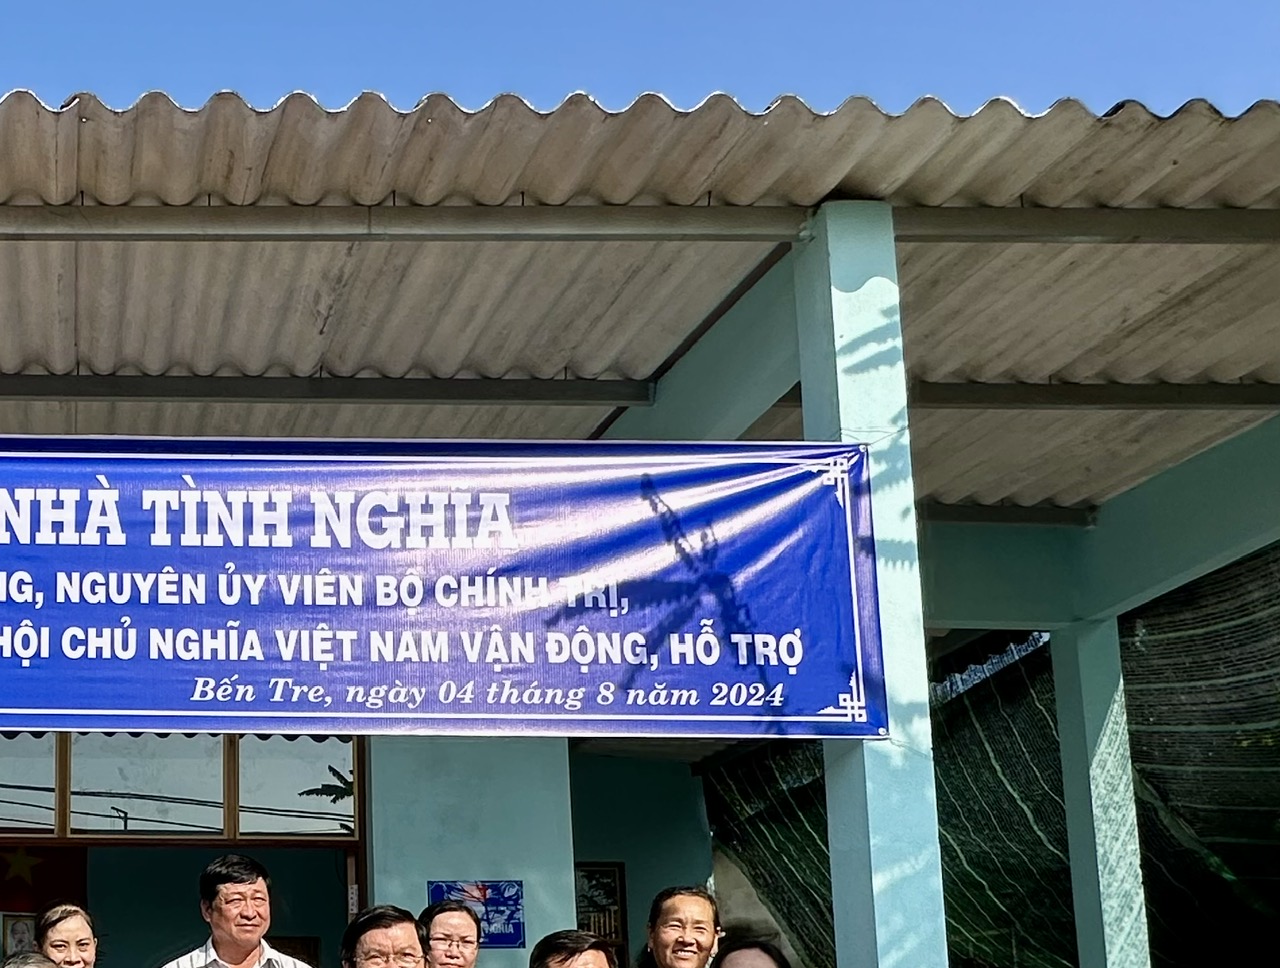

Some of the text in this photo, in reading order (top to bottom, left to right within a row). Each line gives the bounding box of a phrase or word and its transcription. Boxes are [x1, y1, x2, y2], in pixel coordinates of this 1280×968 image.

[141, 474, 294, 548] TÌNH
[57, 566, 207, 605] NGUYÊN
[217, 561, 265, 605] ỦY
[277, 568, 364, 607] VIÊN
[377, 569, 424, 616] BỘ
[435, 567, 550, 609] CHÍNH
[559, 576, 630, 618] TRỊ,
[61, 616, 137, 660] CHỦ
[148, 620, 265, 661] NGHĨA
[275, 622, 358, 671] VIỆT
[370, 629, 450, 663] NAM
[461, 624, 535, 672] VẬN
[546, 625, 659, 672] ĐỘNG,
[670, 618, 722, 666] HỖ
[730, 628, 804, 675] TRỢ
[191, 674, 786, 711] Bến Tre, ngày 04 tháng 8 năm 2024
